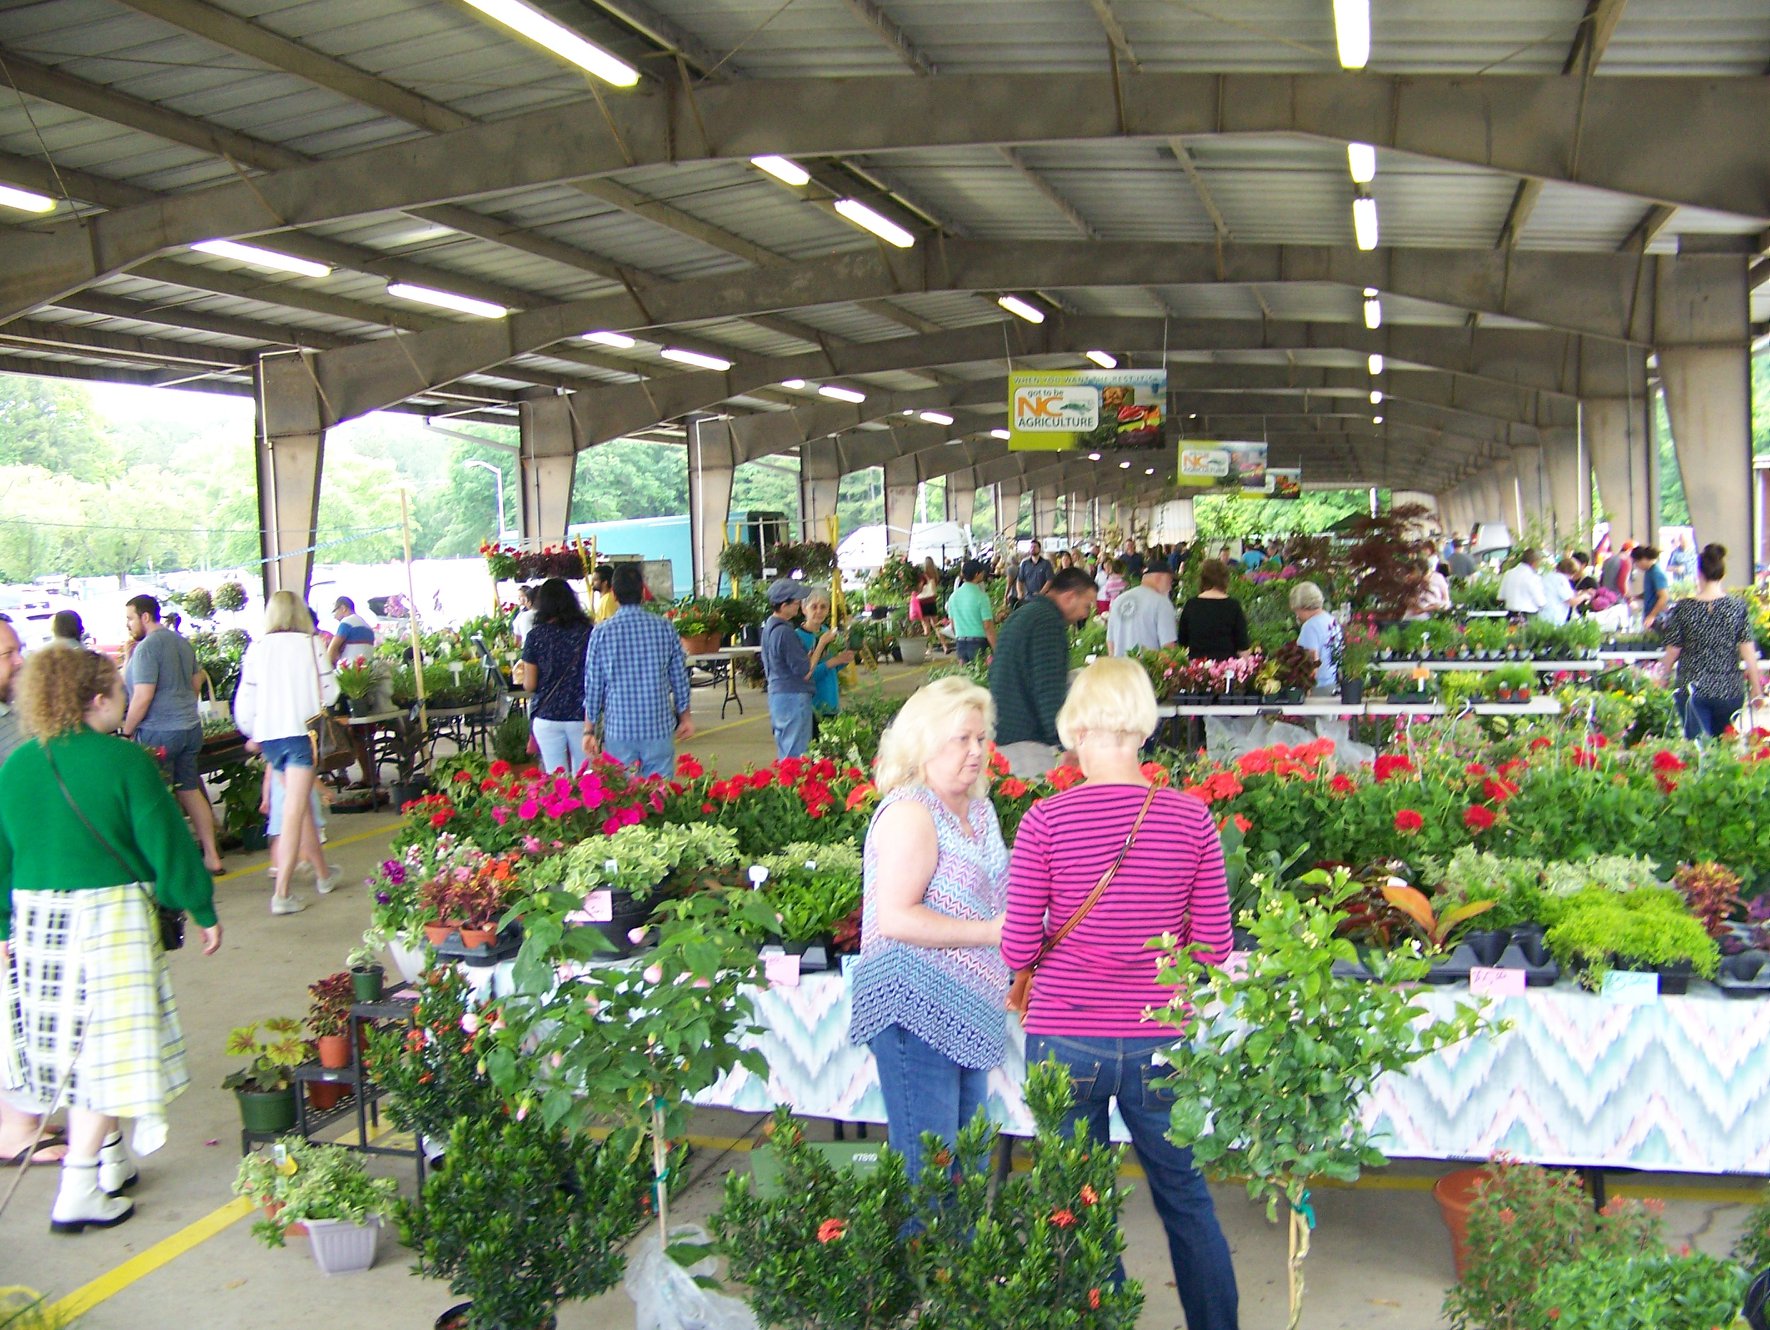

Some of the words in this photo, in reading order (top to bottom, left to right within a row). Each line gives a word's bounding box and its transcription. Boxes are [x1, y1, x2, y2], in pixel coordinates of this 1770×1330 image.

[1014, 376, 1040, 385] WHEN
[1043, 376, 1061, 385] YOU
[1064, 376, 1090, 385] WANT
[1027, 389, 1042, 398] got
[1017, 396, 1063, 417] NC
[1018, 417, 1094, 428] AGRICULTURE
